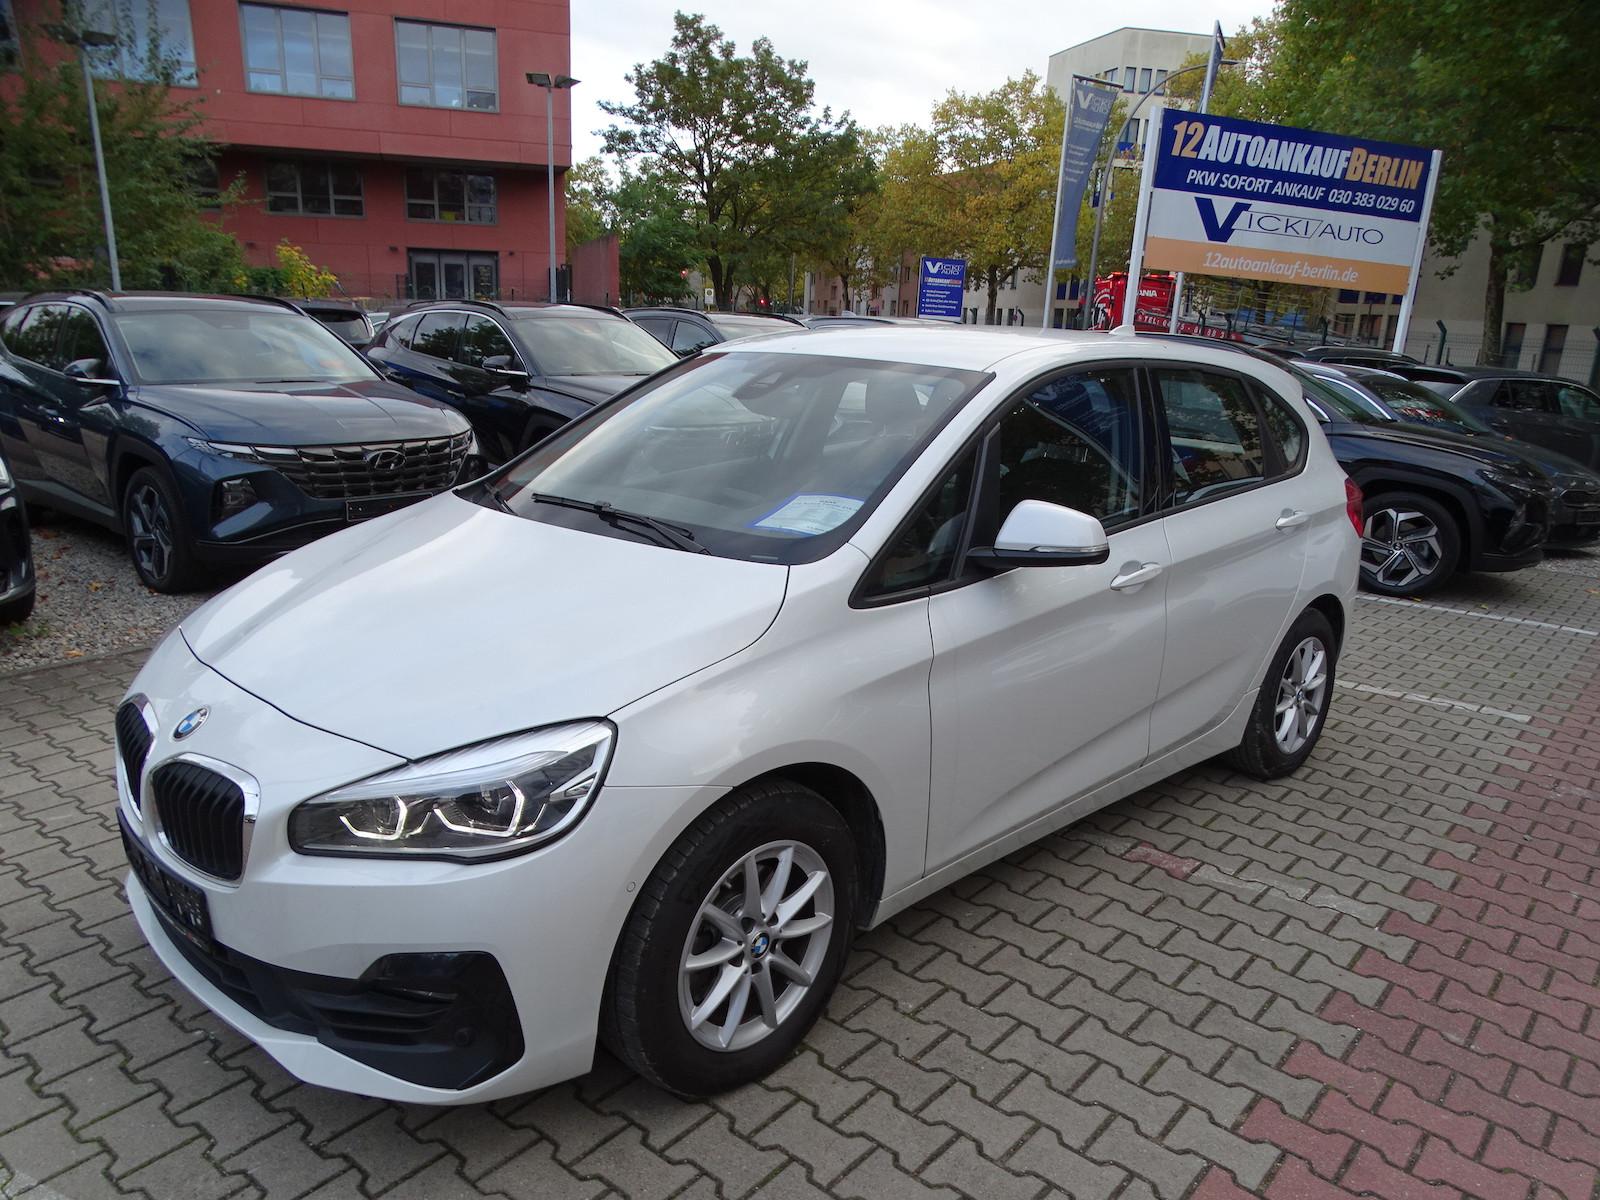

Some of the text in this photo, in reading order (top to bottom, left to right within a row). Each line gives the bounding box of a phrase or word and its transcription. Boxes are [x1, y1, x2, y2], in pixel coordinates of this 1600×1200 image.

[1186, 169, 1415, 213] PKW SOFORT ANKAUF 030 383 029 60
[1194, 196, 1384, 245] VICKI AUTO
[1203, 251, 1359, 283] 12autoankauf-berlin.de
[1138, 289, 1158, 297] ANIA
